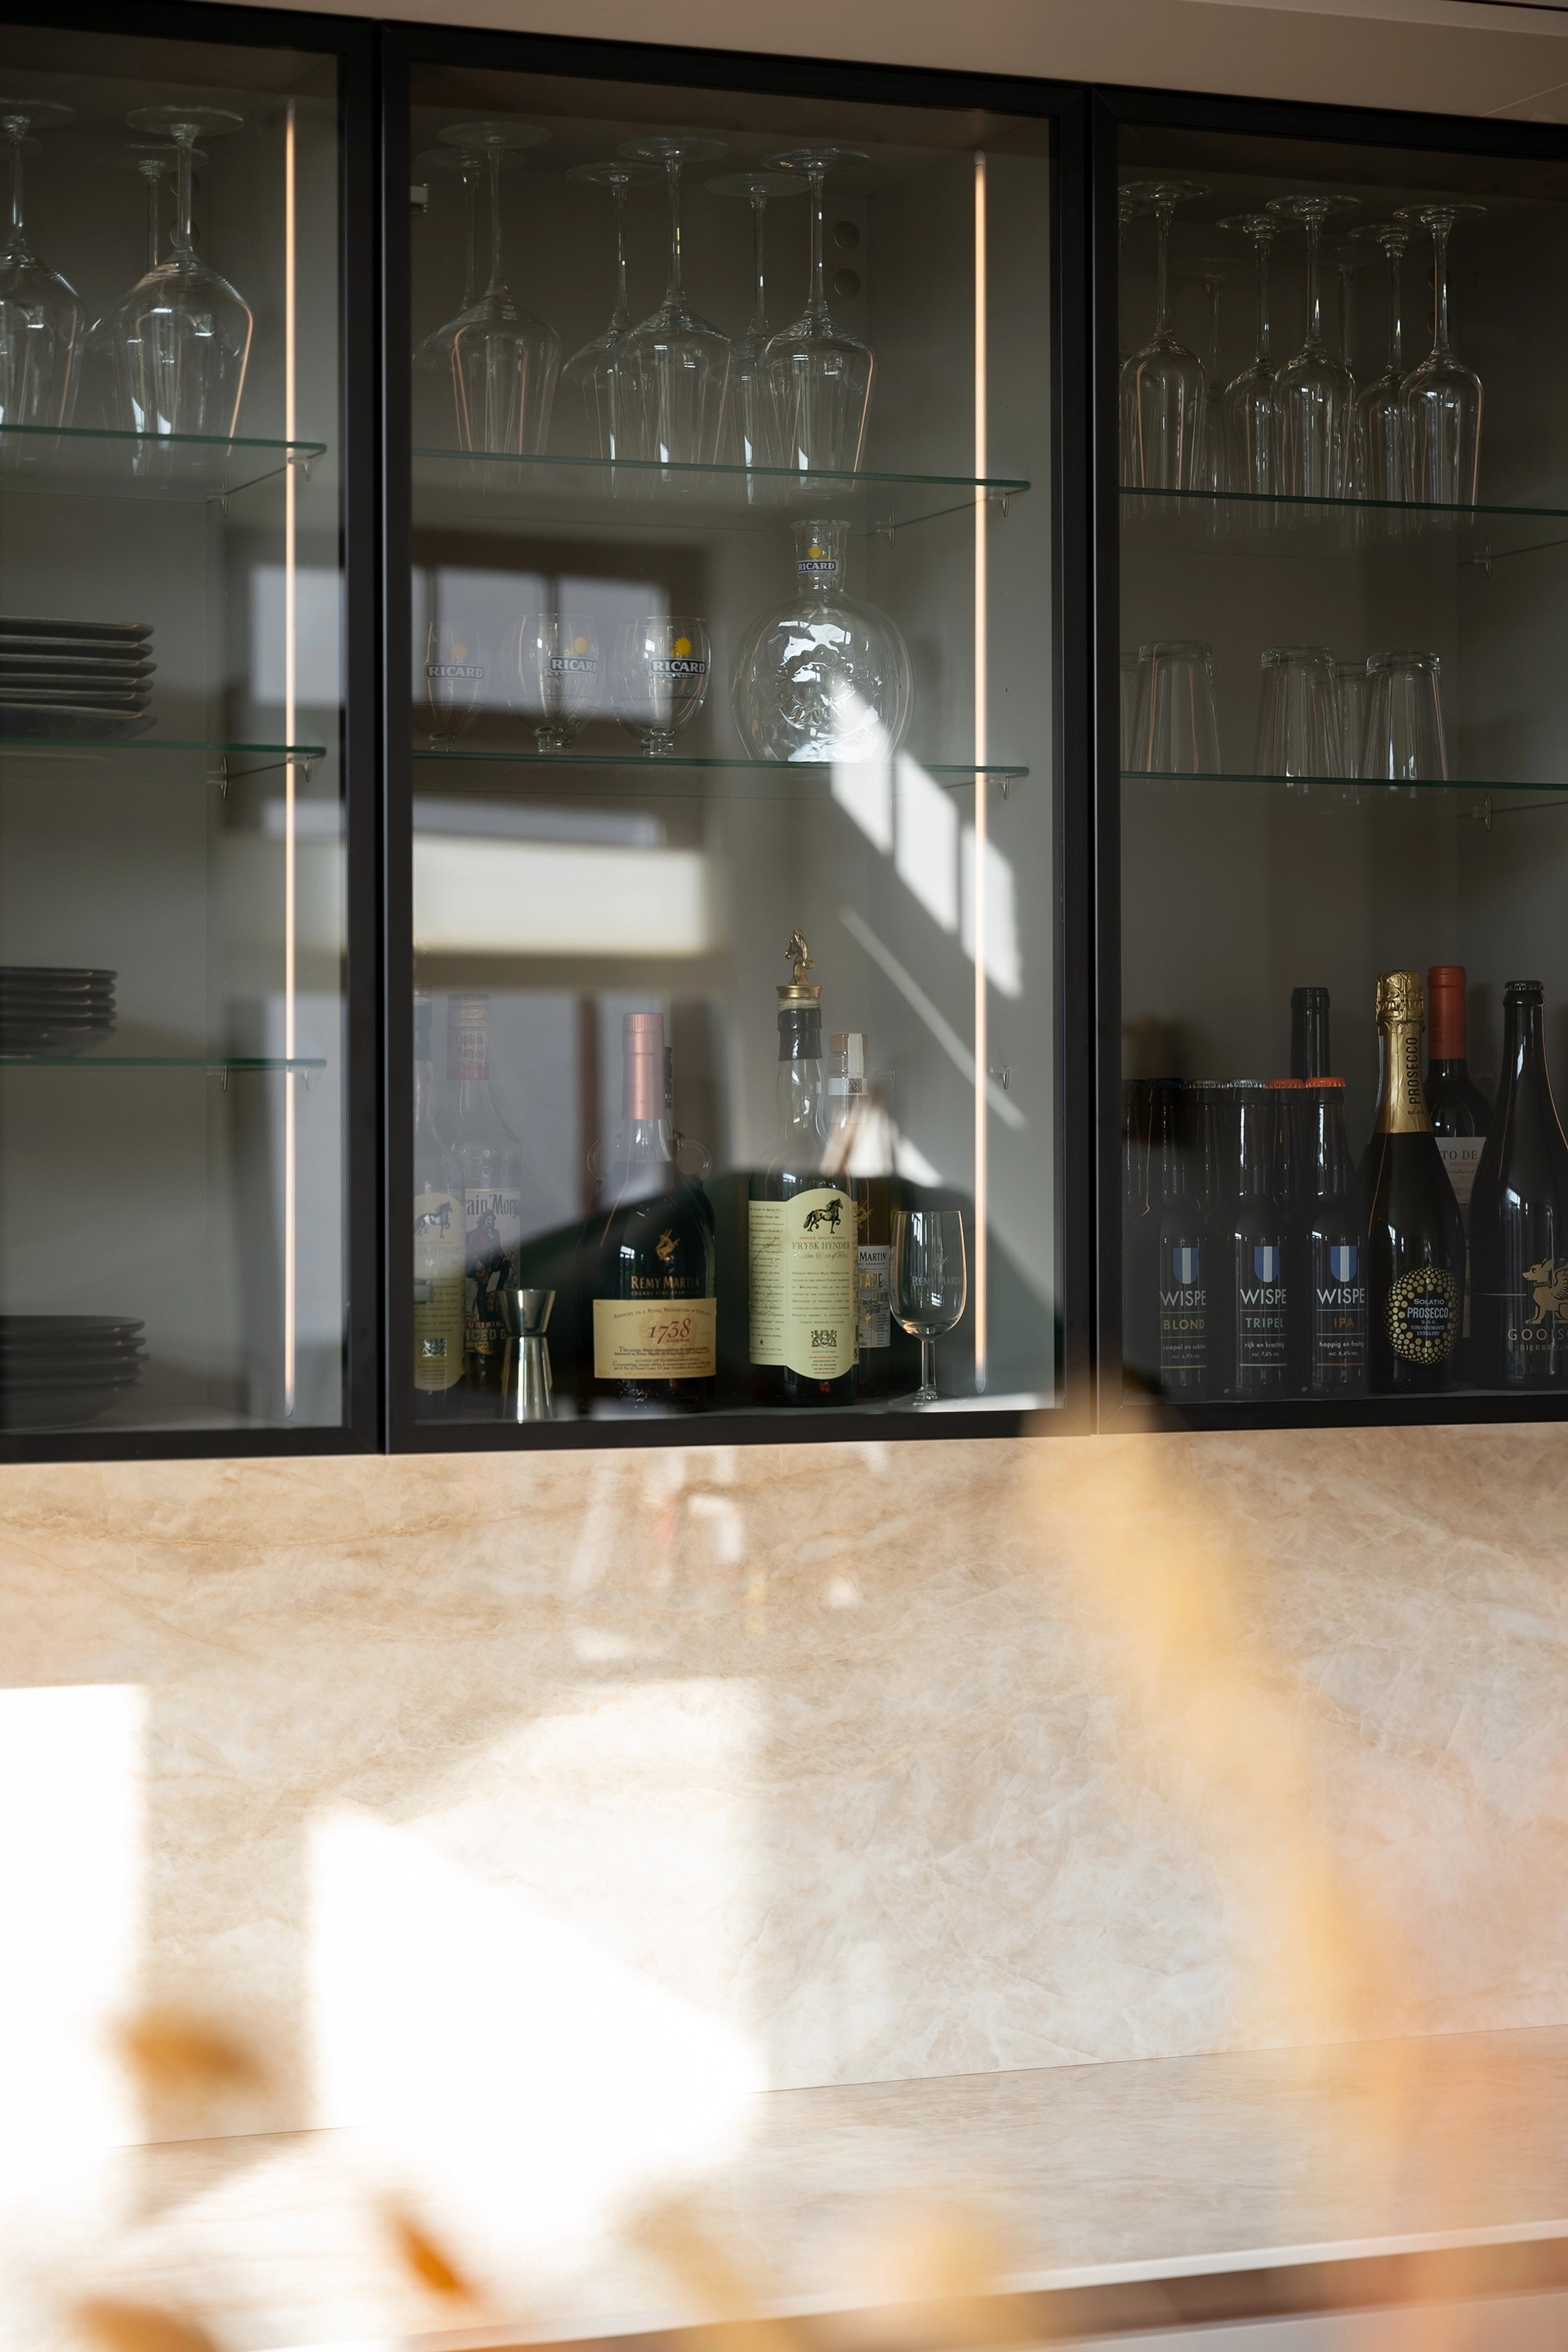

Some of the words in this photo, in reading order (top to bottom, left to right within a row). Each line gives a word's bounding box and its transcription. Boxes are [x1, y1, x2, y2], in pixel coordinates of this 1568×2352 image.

[798, 562, 835, 571] RICARD
[551, 658, 598, 672] RICARD
[652, 661, 706, 674] RICARD
[427, 666, 483, 679] RICARD
[1405, 1037, 1421, 1105] PROSECCO
[1463, 1150, 1477, 1160] DE
[792, 1241, 820, 1250] FRYSK
[822, 1241, 851, 1250] HYNDER
[860, 1251, 887, 1262] MARTIN
[631, 1275, 661, 1290] RÉMY
[663, 1276, 700, 1290] MARTIN
[1160, 1290, 1206, 1307] WISPE
[1240, 1289, 1287, 1305] WISPE
[1316, 1288, 1365, 1305] WISPE
[1407, 1307, 1449, 1319] PROSECCO
[1163, 1319, 1205, 1330] BLOND
[1245, 1317, 1284, 1328] TRIPEL
[1334, 1317, 1355, 1328] IPA
[648, 1318, 692, 1344] 1738
[1508, 1329, 1568, 1340] GOOIS
[1162, 1343, 1183, 1352] soepel
[1319, 1340, 1342, 1349] hoppig
